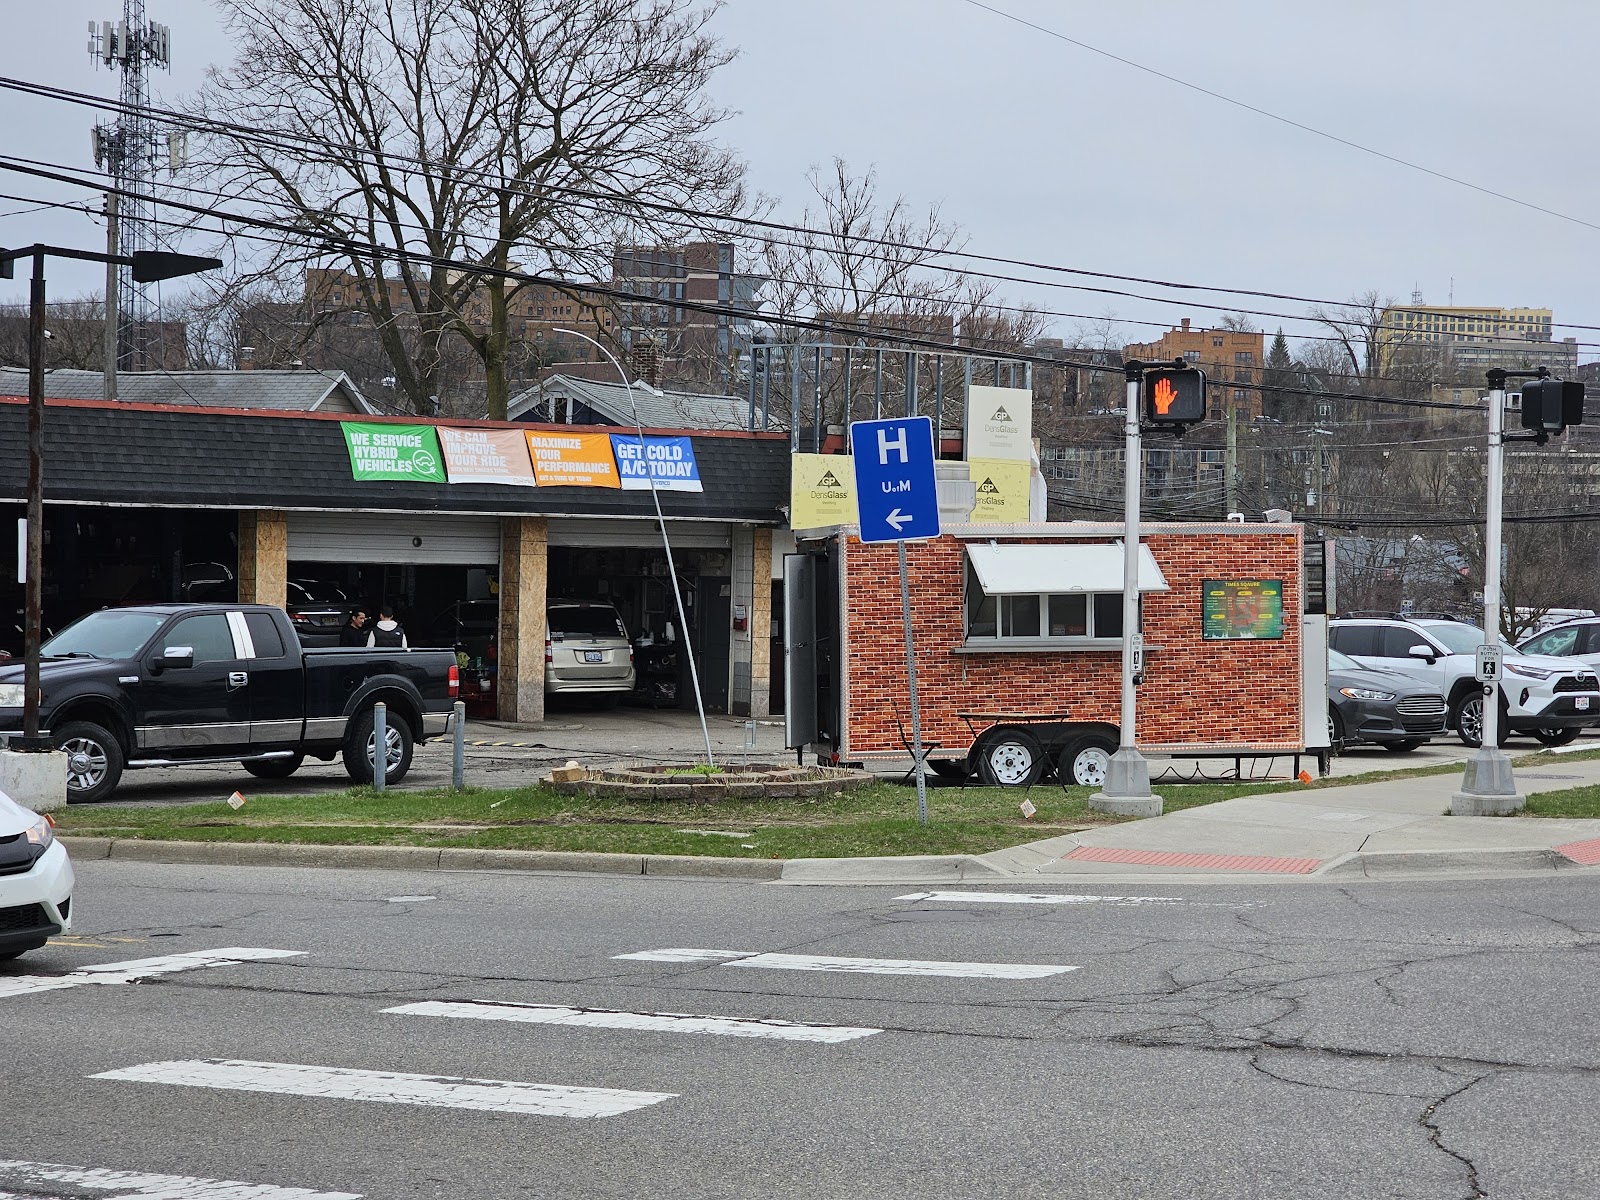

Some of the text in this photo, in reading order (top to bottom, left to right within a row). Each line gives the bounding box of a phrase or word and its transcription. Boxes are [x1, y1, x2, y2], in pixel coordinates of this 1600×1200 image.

[994, 412, 1007, 420] GP
[984, 424, 1018, 434] DensGlass
[350, 433, 422, 447] WE SERVICE
[444, 430, 488, 443] WE CAN
[447, 442, 496, 455] IMPROVE
[532, 437, 582, 450] MAXIMIZE
[877, 428, 908, 464] H
[354, 446, 398, 459] HYBRID
[534, 449, 561, 460] YOUR
[618, 444, 682, 460] GET COLD
[356, 459, 412, 472] VEHICLES
[449, 454, 507, 467] YOUR RIDE
[538, 461, 610, 474] PERFORMANCE
[622, 460, 692, 477] A/C TODAY
[822, 477, 836, 486] GP
[811, 490, 848, 499] DensGlass
[976, 497, 1004, 506] ensGlass
